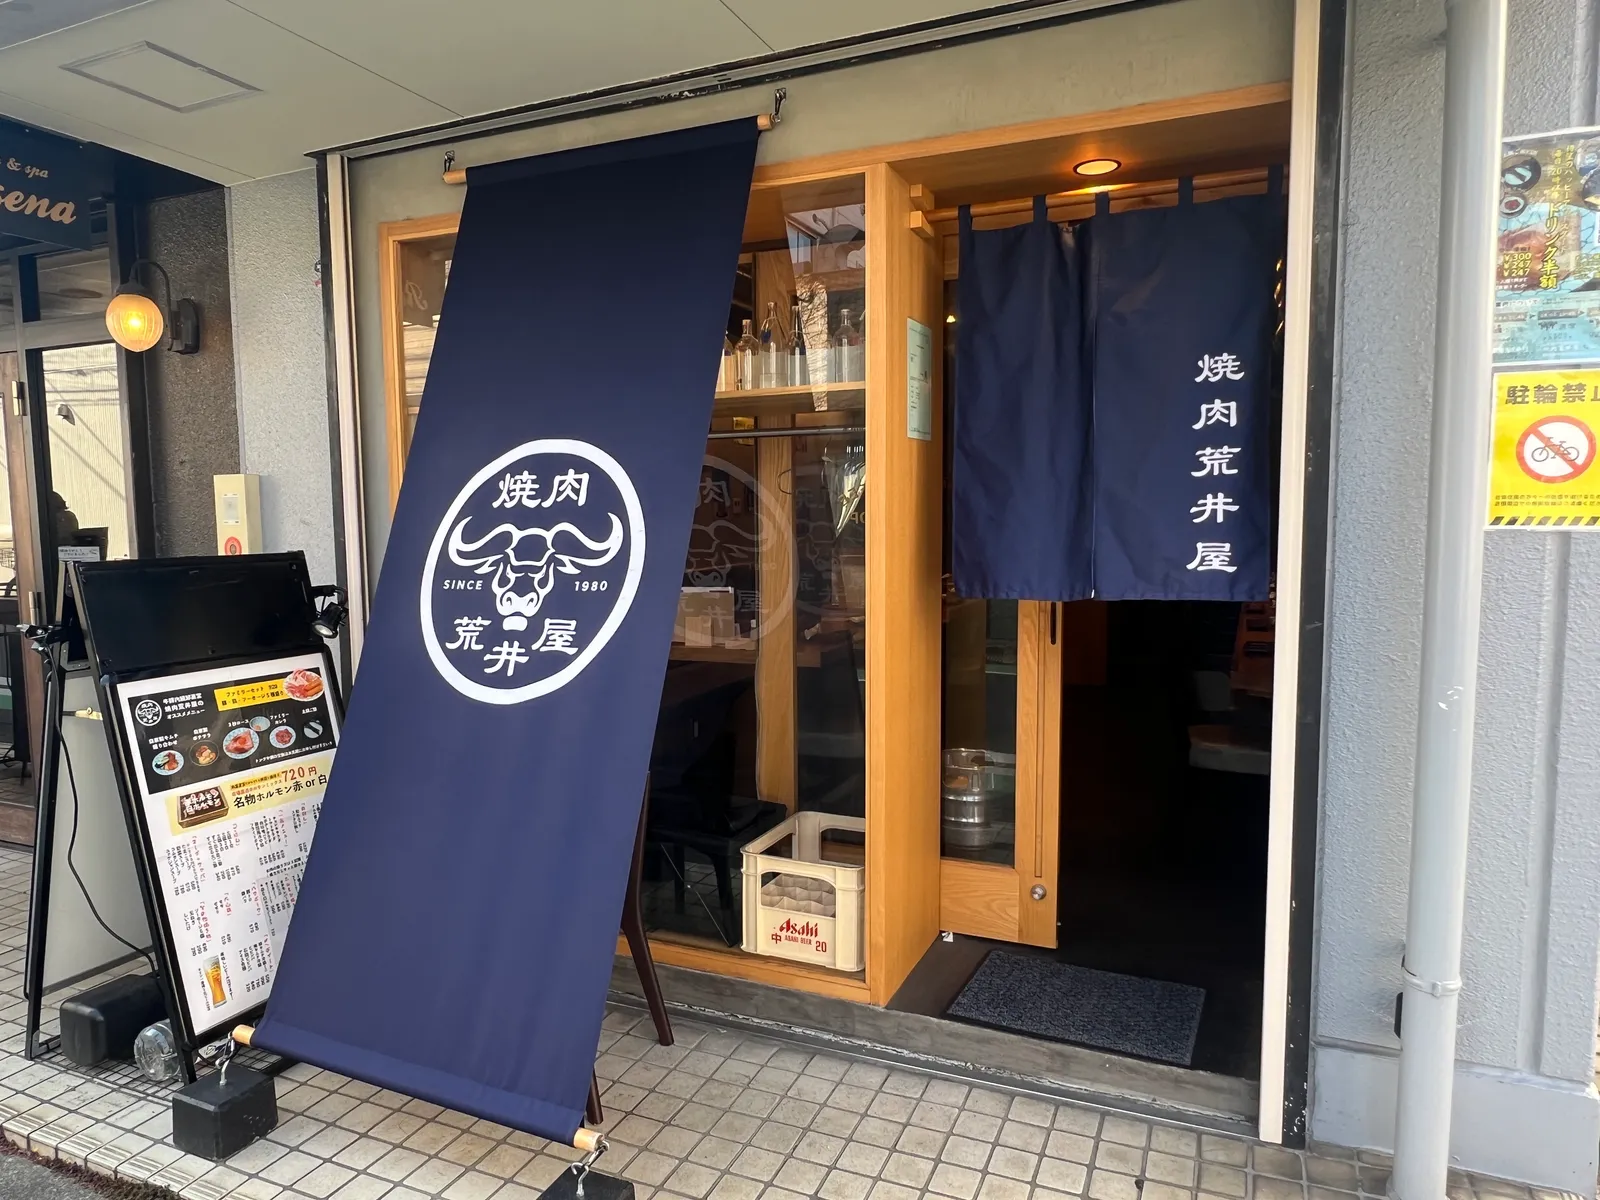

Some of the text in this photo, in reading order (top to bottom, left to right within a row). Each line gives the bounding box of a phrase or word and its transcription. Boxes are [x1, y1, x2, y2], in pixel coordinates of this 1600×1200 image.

[6, 157, 49, 179] & spa
[1539, 201, 1561, 289] ドリンク半額
[1186, 352, 1245, 574] 焼肉荒井屋
[491, 468, 590, 509] 焼肉
[442, 579, 609, 592] SINCE 1980
[233, 780, 303, 809] 名物ホルモン赤
[305, 779, 316, 787] or
[317, 774, 327, 784] 白
[771, 932, 782, 944] 中
[779, 918, 818, 938] Asahi
[815, 941, 827, 953] 20
